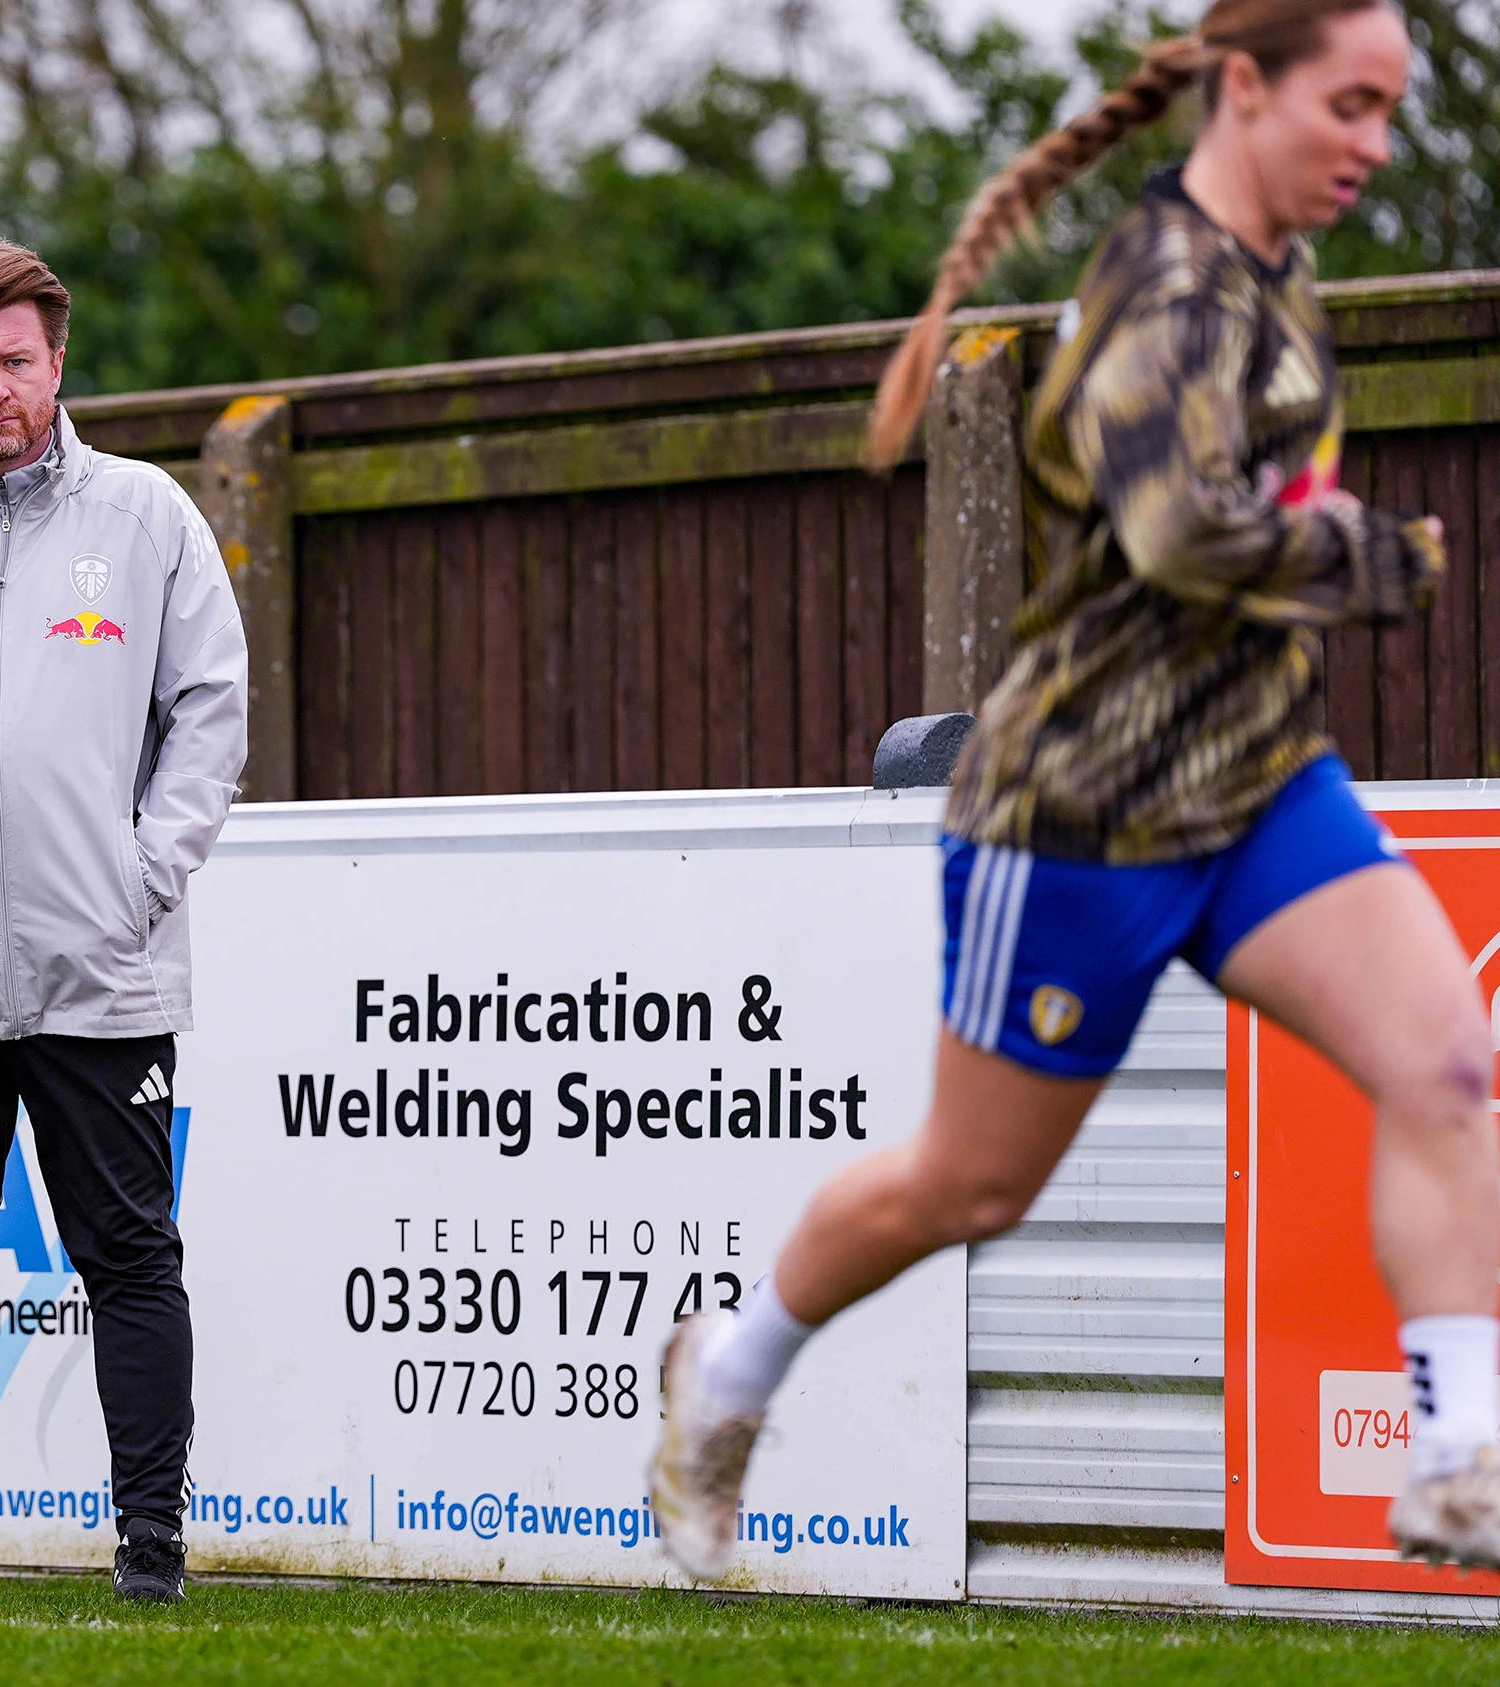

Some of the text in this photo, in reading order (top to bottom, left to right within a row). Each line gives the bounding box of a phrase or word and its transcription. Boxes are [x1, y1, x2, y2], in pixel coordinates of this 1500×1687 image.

[355, 971, 783, 1043] Fabrication &
[277, 1067, 867, 1158] Welding Specialist
[394, 1218, 741, 1257] TELEPHONE
[345, 1266, 743, 1337] 03330 177 43
[394, 1359, 535, 1417] 07720
[555, 1363, 639, 1420] 388
[1333, 1407, 1419, 1449] 0794
